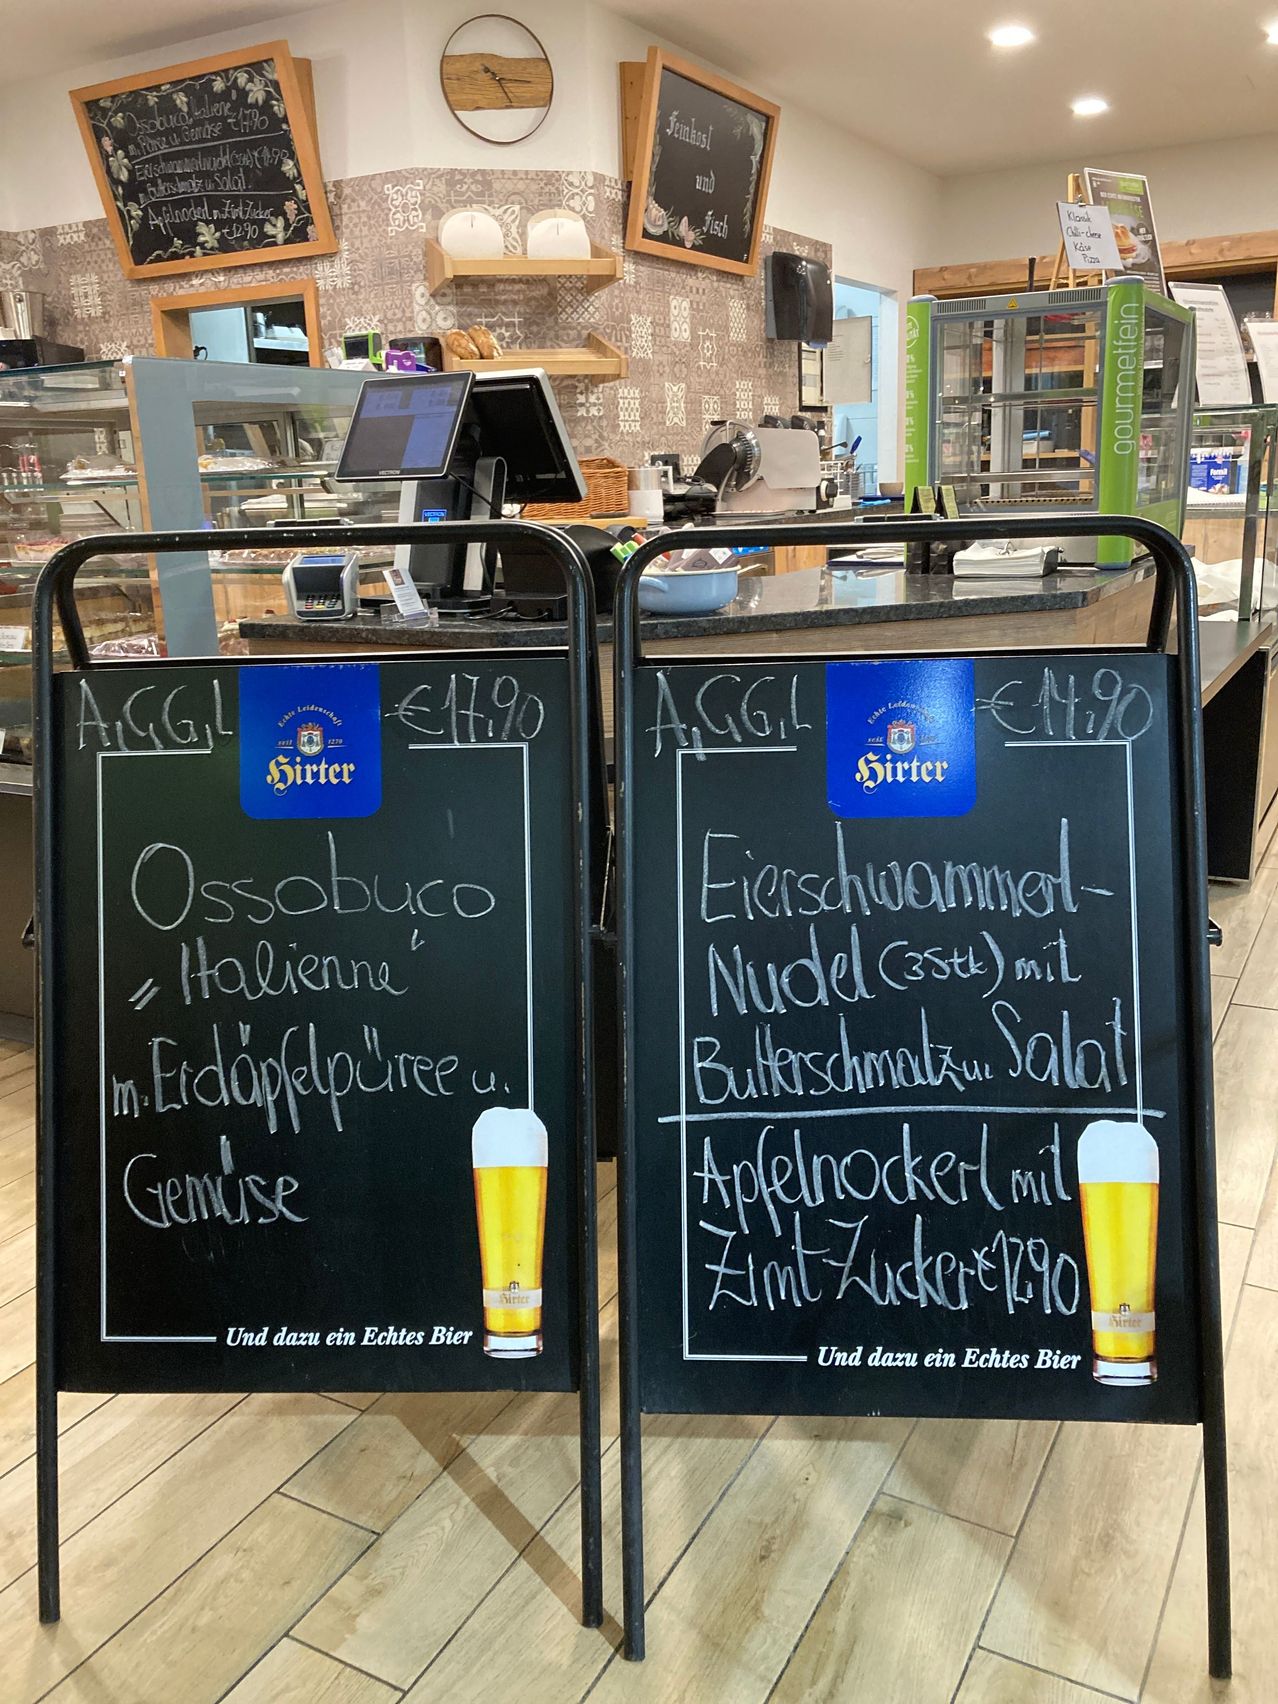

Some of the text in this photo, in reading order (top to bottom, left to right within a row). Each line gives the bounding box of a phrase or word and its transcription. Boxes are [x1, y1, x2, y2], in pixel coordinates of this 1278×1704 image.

[666, 110, 714, 151] Feinkost
[695, 169, 716, 194] und
[702, 210, 728, 239] Fisch
[1112, 303, 1140, 455] gourmetfein
[266, 754, 356, 796] Hirter
[854, 751, 949, 795] Hirter
[131, 831, 496, 931] Ossobuco
[707, 922, 877, 1017] Nudel
[991, 997, 1129, 1094] Salat
[226, 1324, 474, 1348] Und dazu ein Echtes Bier
[816, 1345, 1083, 1370] Und dazu ein Echtes Bier
